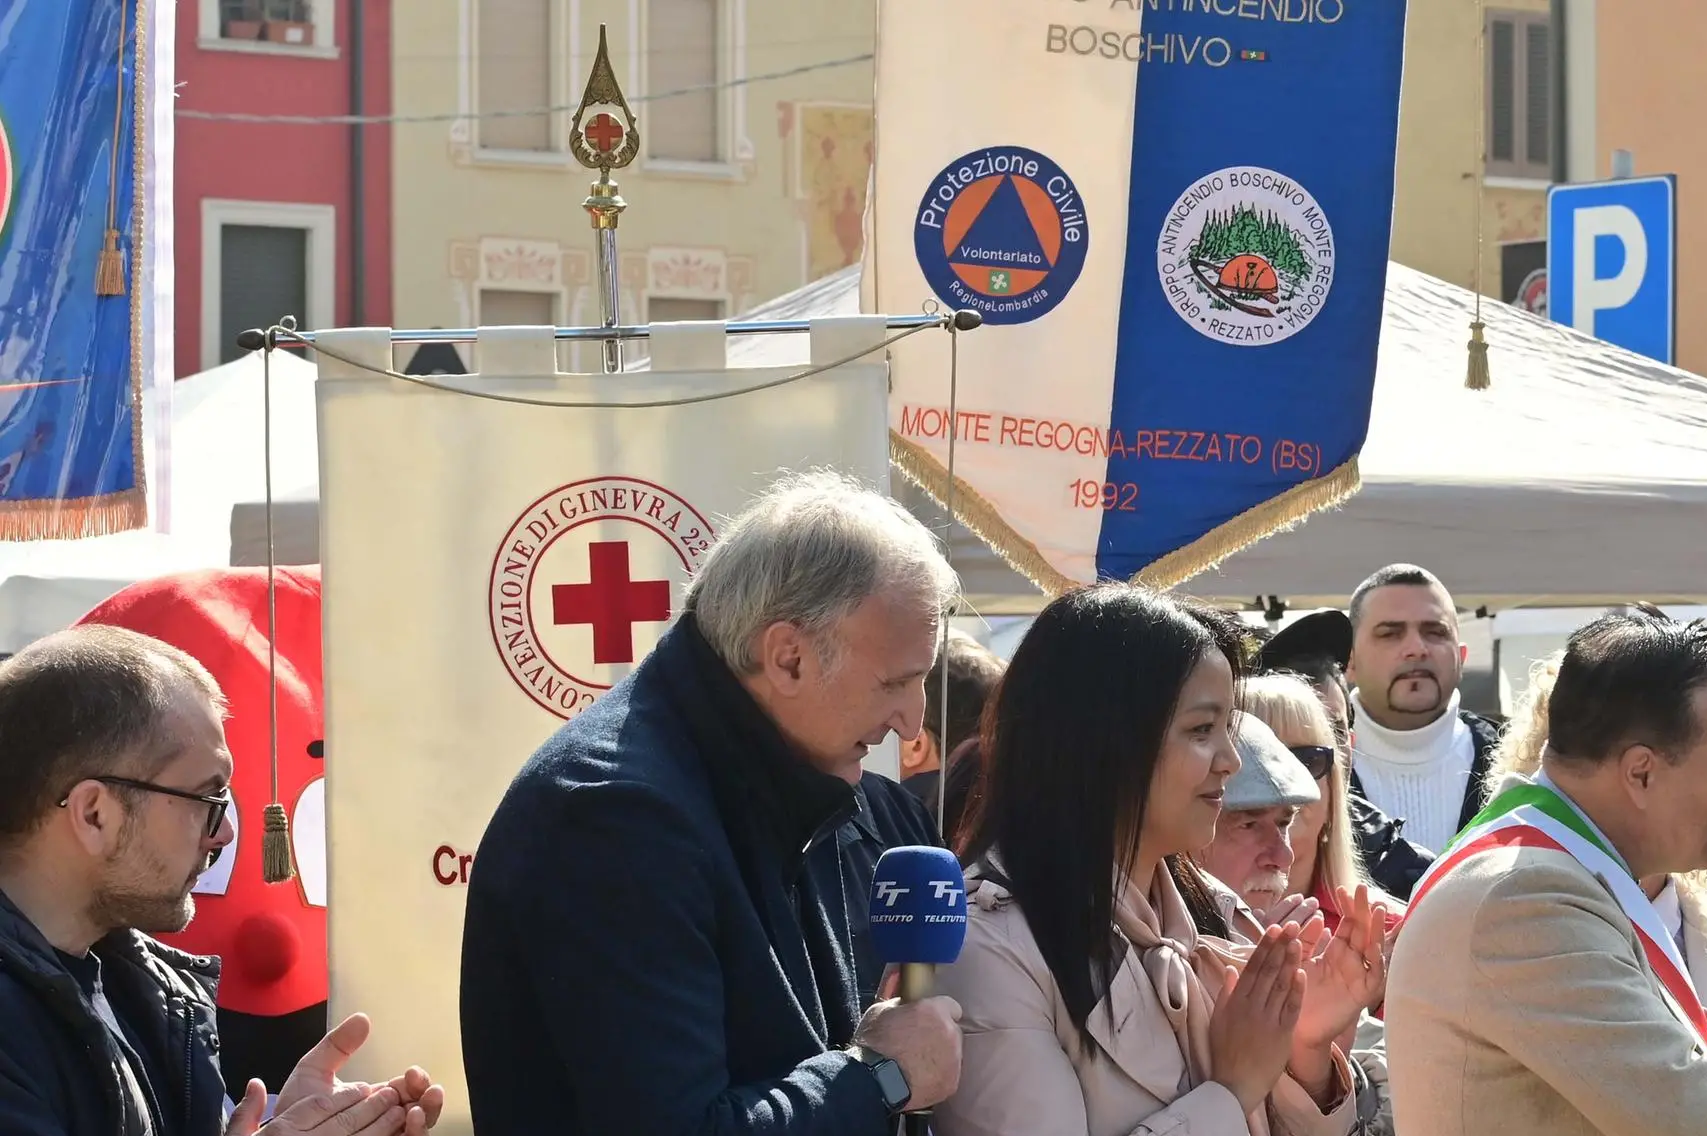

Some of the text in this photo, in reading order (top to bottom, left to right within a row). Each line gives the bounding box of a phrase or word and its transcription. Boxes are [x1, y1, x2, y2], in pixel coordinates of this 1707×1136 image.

[1046, 24, 1231, 67] BOSCHIVO
[920, 152, 1084, 242] Protezione Civile
[960, 246, 1041, 264] Volontariato
[1162, 172, 1332, 328] GRUPPO ANTINCENDIO BOSCHIVO MONTE REGOGNA
[1572, 204, 1648, 338] P
[1208, 318, 1274, 341] REZZATO
[900, 405, 991, 442] MONTE
[1271, 438, 1321, 476] (BS)
[1068, 478, 1139, 511] 1992
[525, 508, 560, 543] DI
[559, 487, 682, 533] GINEVRA
[680, 527, 709, 557] 22
[432, 845, 473, 886] Cr
[871, 914, 914, 923] TELETUTTO
